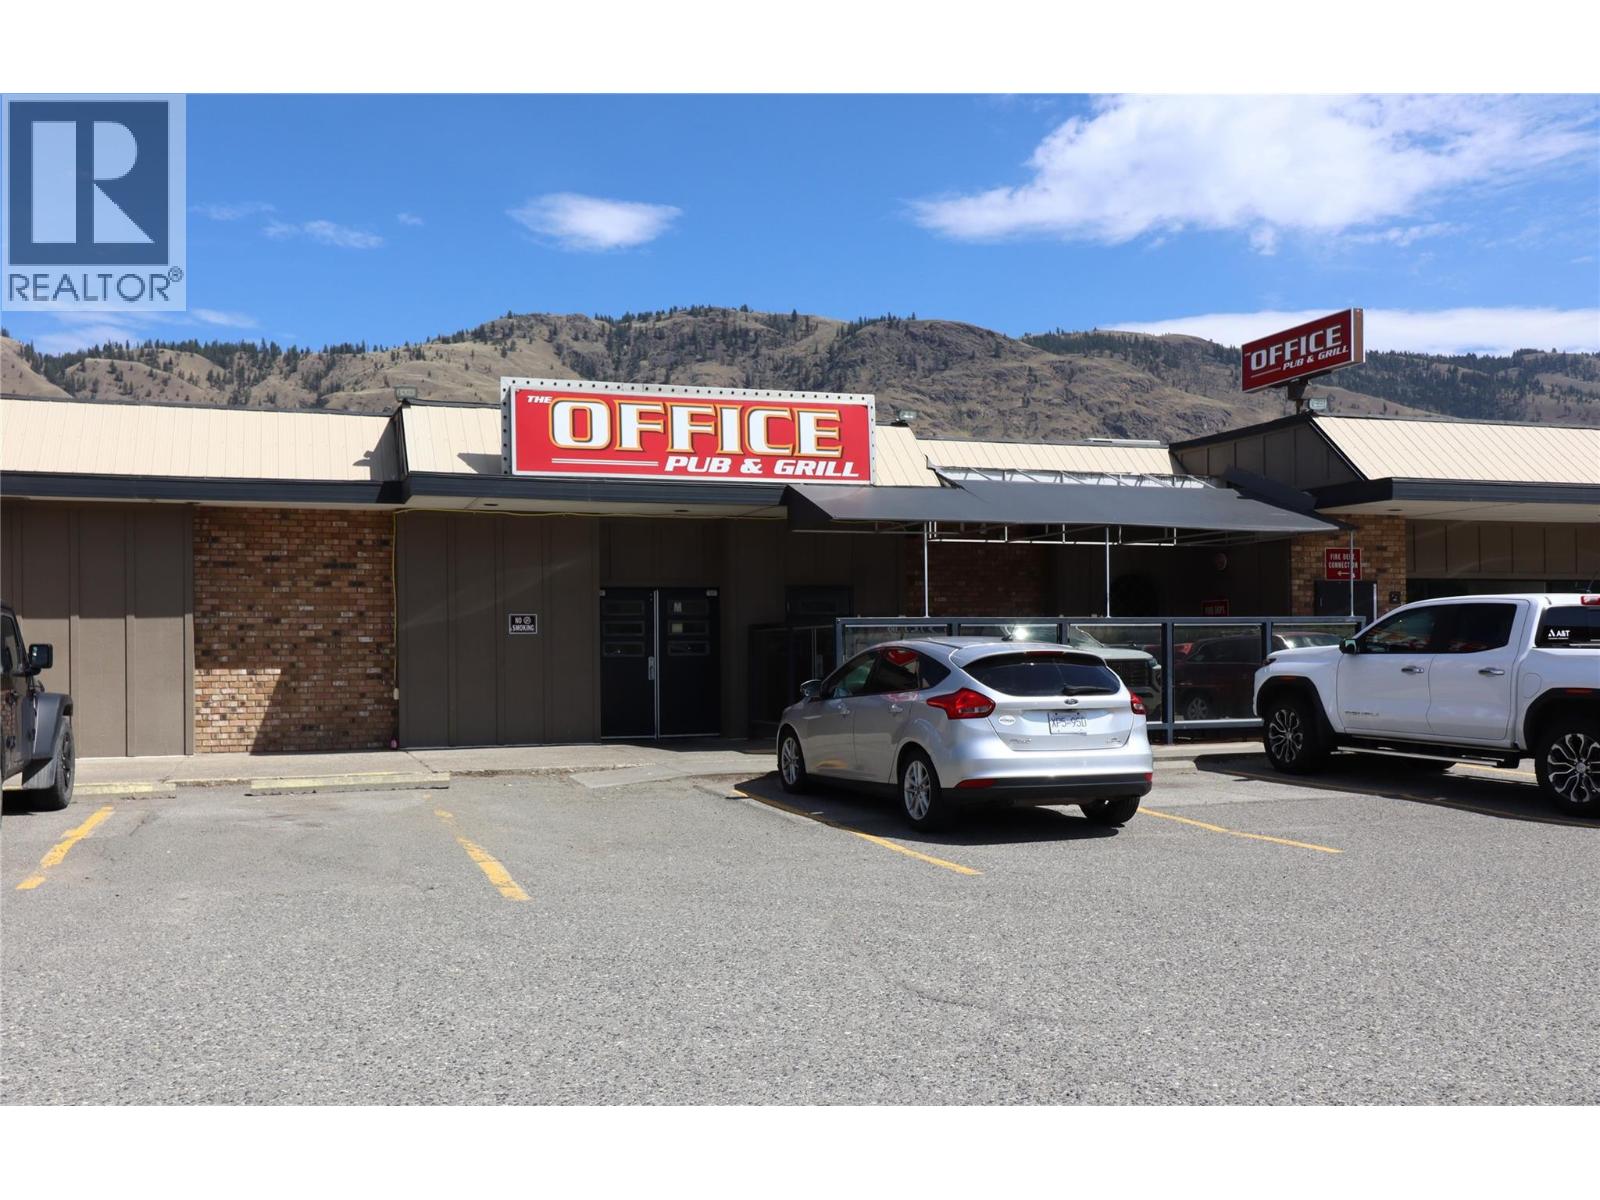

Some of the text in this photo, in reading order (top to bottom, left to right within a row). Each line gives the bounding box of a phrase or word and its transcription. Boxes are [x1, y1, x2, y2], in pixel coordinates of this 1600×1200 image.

[1250, 325, 1342, 371] OFFICE
[1282, 345, 1349, 371] PUB & GRILL
[527, 395, 552, 404] THE
[549, 397, 844, 459] OFFICE
[664, 456, 860, 478] PUB & GRILL
[1328, 561, 1359, 569] CONNECTON
